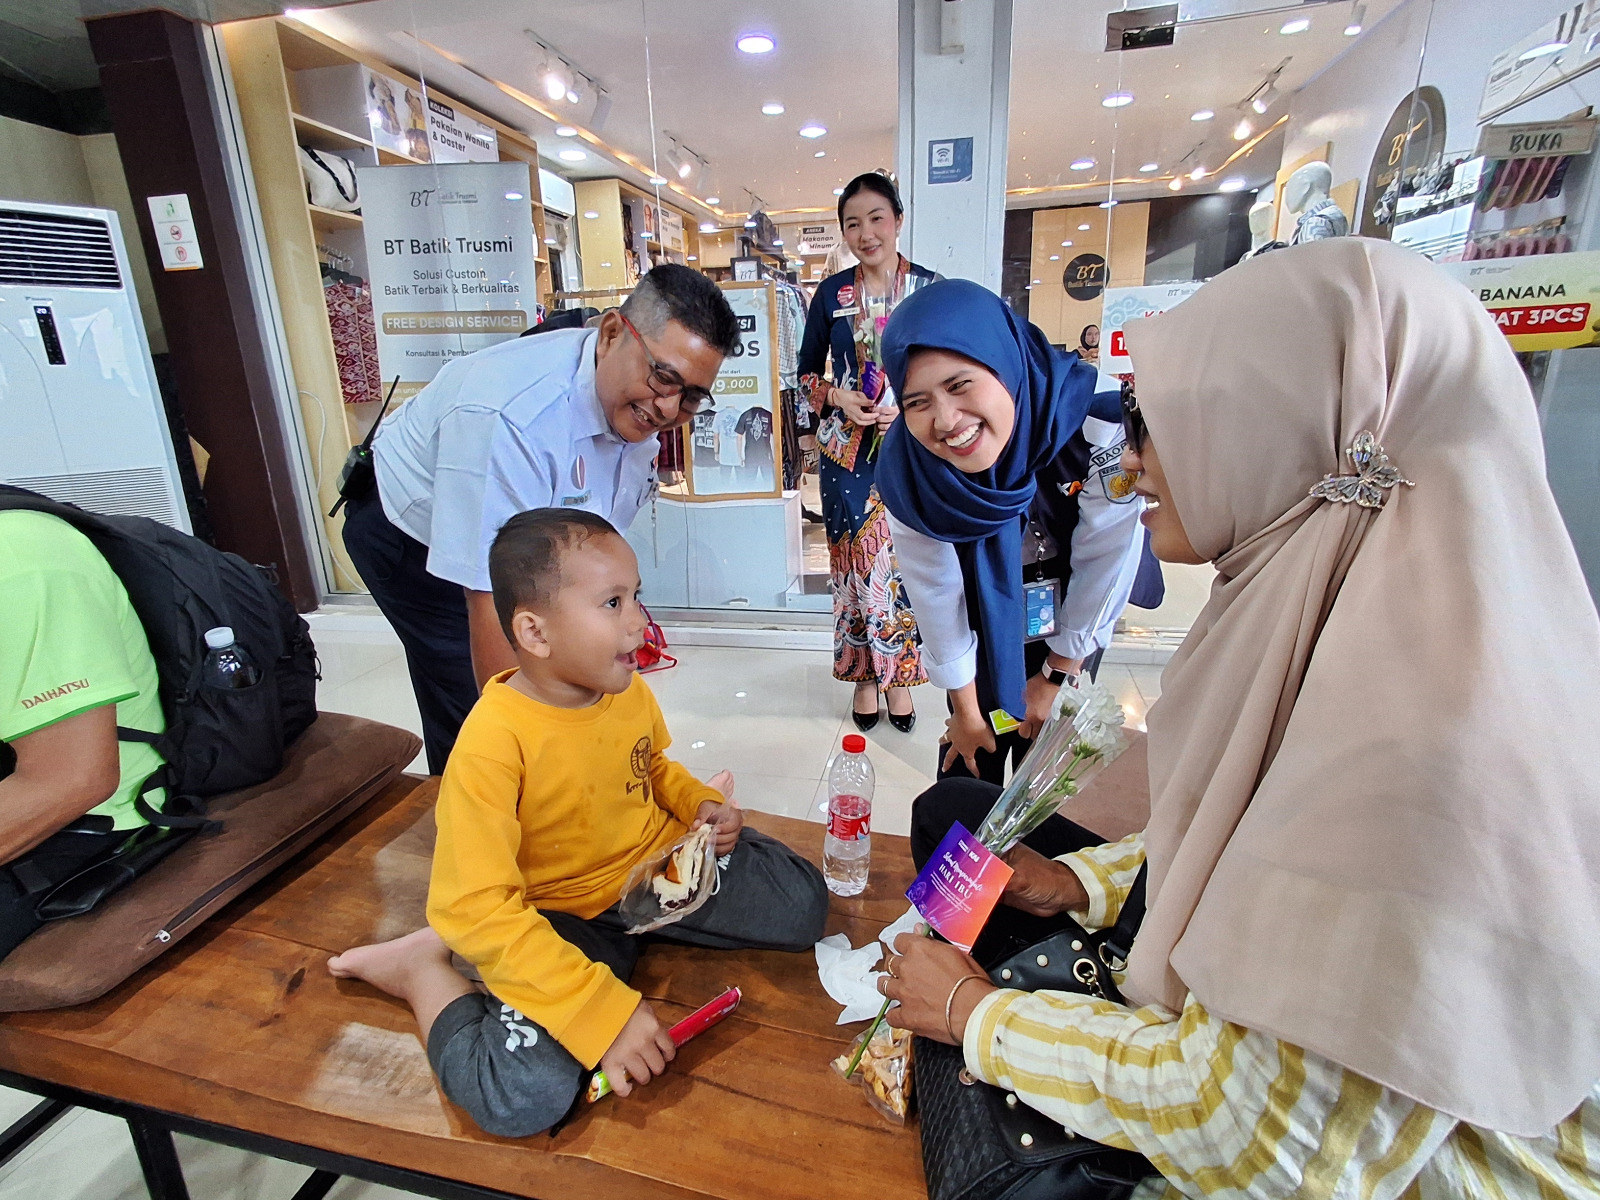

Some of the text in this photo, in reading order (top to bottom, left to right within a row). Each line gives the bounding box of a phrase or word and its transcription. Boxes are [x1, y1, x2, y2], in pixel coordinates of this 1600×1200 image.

[430, 116, 490, 150] Pakaian Wanita
[432, 131, 466, 152] & Daster
[1509, 132, 1563, 154] BUKA
[409, 189, 435, 208] BT
[384, 236, 513, 255] BT Batik Trusmi
[413, 269, 486, 281] Solusi Custom
[1076, 262, 1104, 280] BT
[384, 283, 520, 296] Batik Terbaik & Berkualitas
[1480, 284, 1567, 301] BANANA
[386, 315, 522, 329] FREE DESIGN SERVICE!
[1526, 306, 1586, 326] 3PCS
[405, 349, 440, 357] Konsultasi
[441, 349, 446, 357] &
[711, 378, 754, 393] 9.000
[1101, 465, 1120, 475] KERE
[21, 678, 90, 710] DAIHATSU
[938, 863, 955, 884] HARI
[954, 880, 974, 899] IBU
